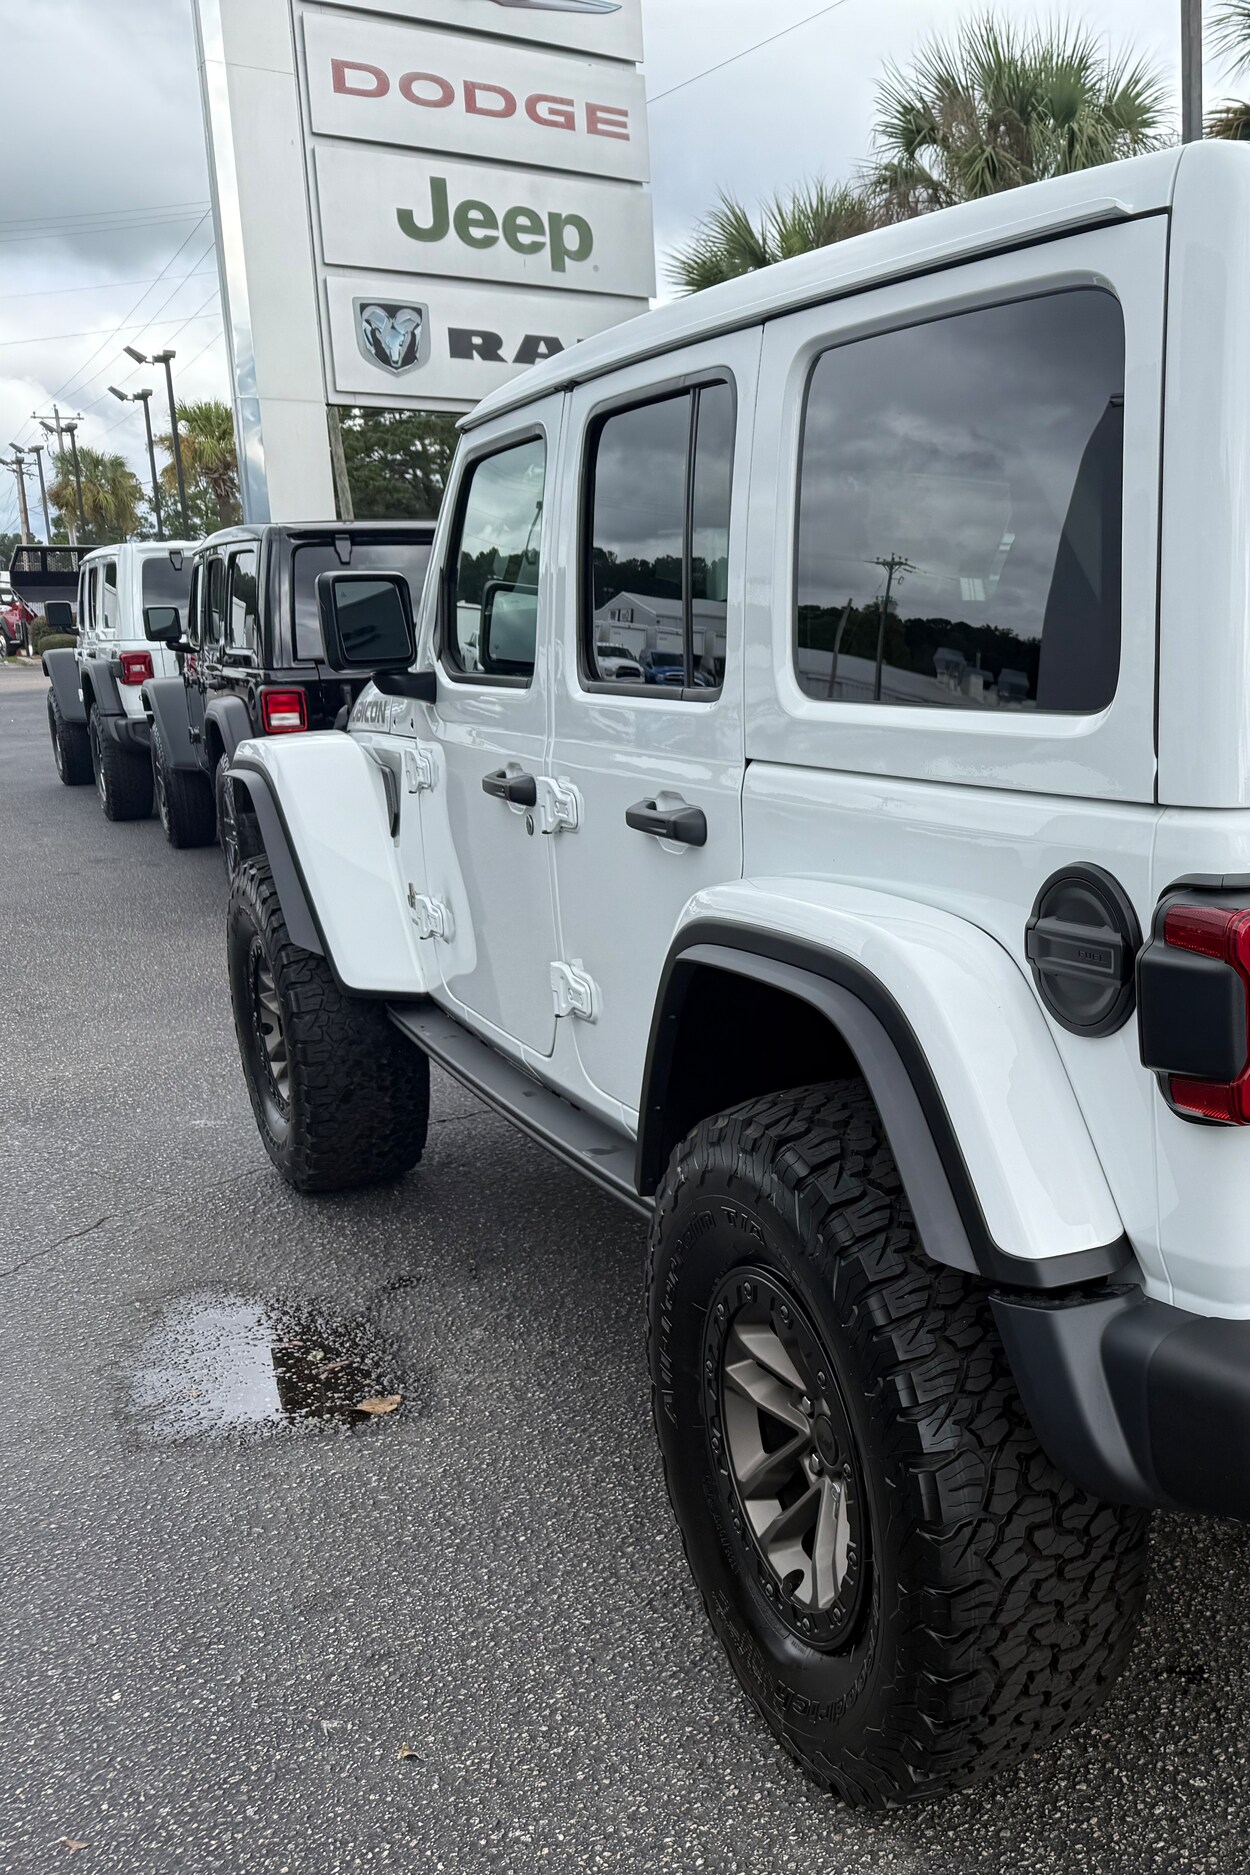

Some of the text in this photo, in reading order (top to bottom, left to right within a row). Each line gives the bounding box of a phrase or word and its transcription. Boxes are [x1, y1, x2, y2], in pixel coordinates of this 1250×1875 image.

[331, 58, 630, 142] DODGE
[396, 175, 594, 273] Jeep
[448, 327, 588, 366] RA
[352, 700, 387, 724] BICON
[1078, 950, 1108, 964] FUEL
